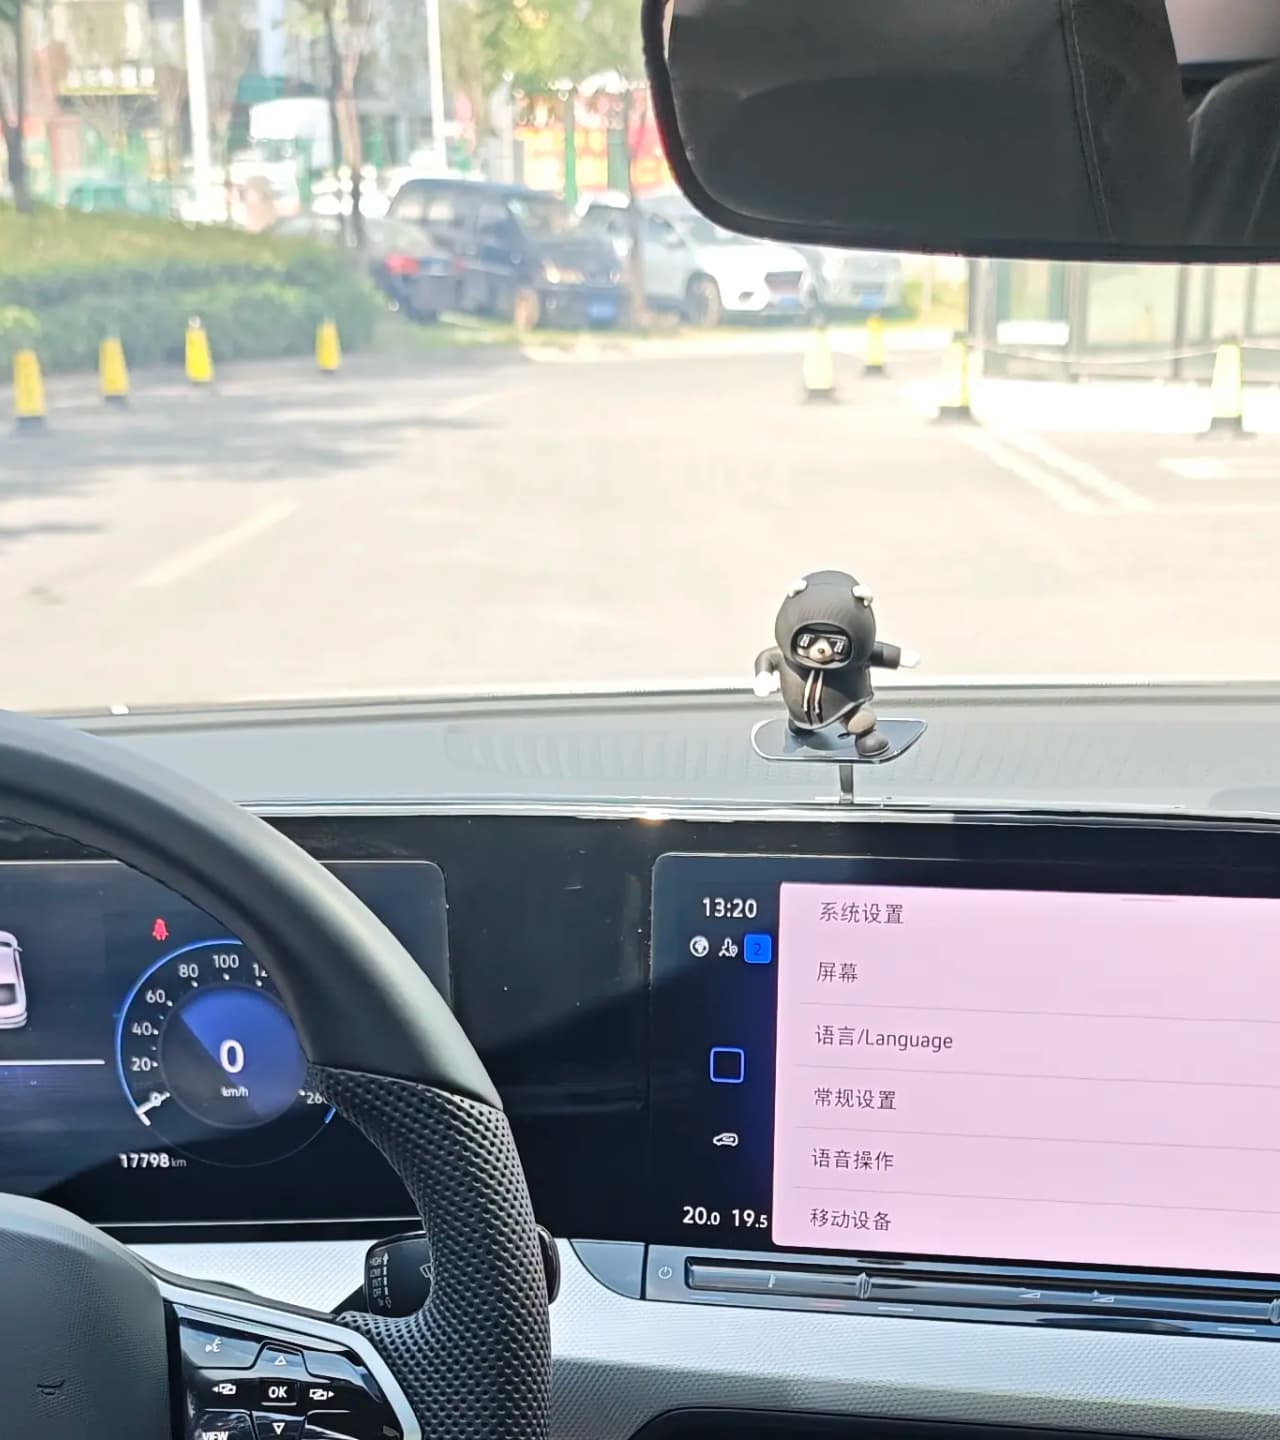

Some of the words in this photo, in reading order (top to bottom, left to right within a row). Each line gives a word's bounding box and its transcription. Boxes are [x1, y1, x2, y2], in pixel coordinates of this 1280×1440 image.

[701, 897, 758, 918] 13:20
[819, 901, 904, 925] 系统设置
[178, 964, 199, 978] 80
[213, 954, 239, 969] 100
[816, 961, 859, 984] 屏幕
[145, 989, 166, 1004] 60
[131, 1022, 153, 1036] 40
[815, 1024, 954, 1053] 语言/Language
[130, 1057, 151, 1072] 20
[219, 1039, 245, 1074] 0
[221, 1086, 249, 1098] km/h
[814, 1087, 897, 1111] 常规设置
[119, 1153, 170, 1169] 17798
[171, 1157, 187, 1168] km
[811, 1148, 895, 1172] 语音操作
[682, 1205, 721, 1226] 20.0
[731, 1208, 769, 1229] 19.5
[809, 1207, 892, 1232] 移动设备
[268, 1386, 289, 1399] OK
